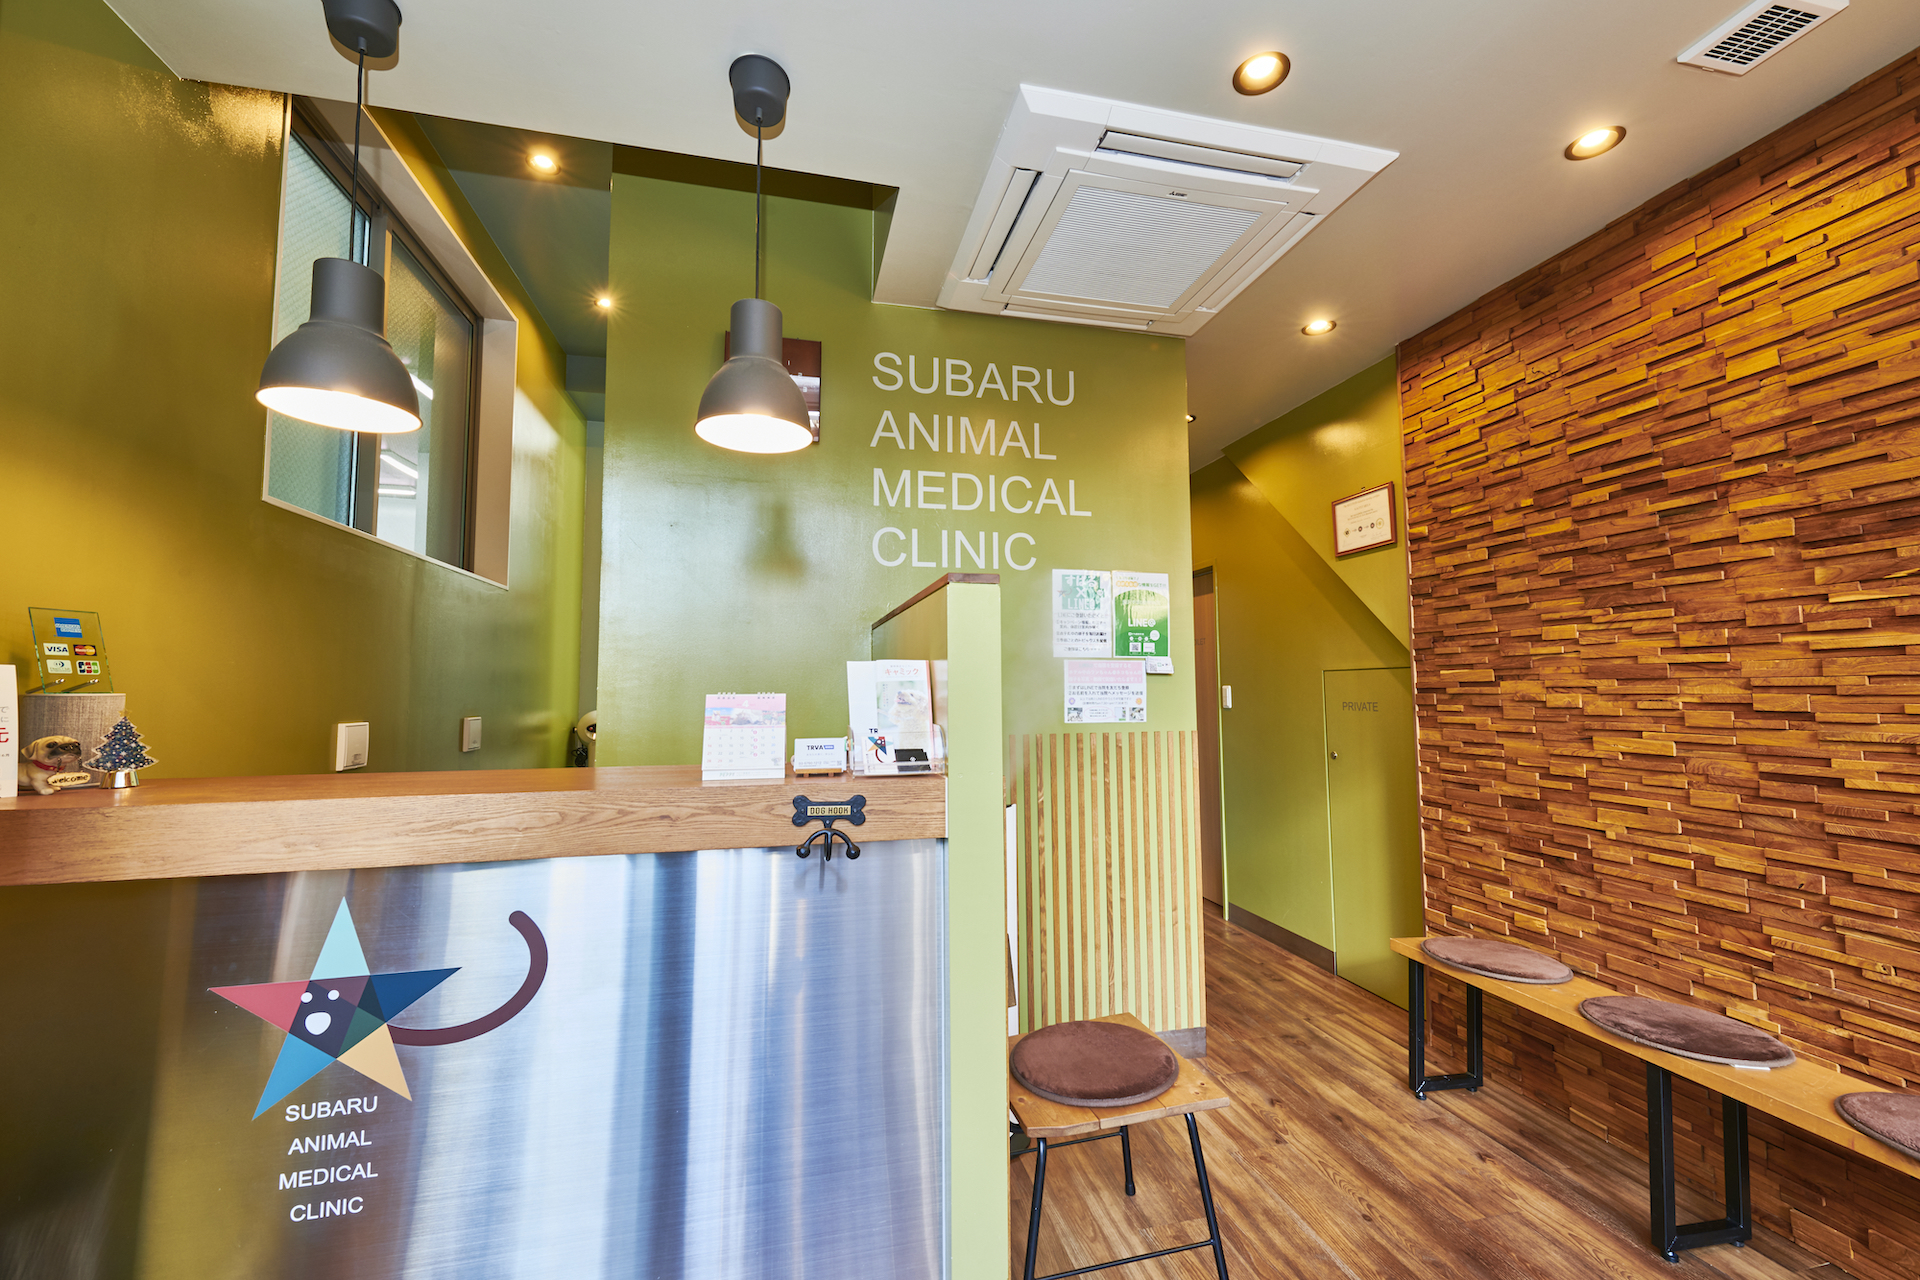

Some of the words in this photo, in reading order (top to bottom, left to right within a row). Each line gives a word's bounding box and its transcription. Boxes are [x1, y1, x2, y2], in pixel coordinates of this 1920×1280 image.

[872, 352, 1074, 406] SUBARU
[870, 410, 1057, 460] ANIMAL
[873, 468, 1092, 517] MEDICAL
[872, 527, 1036, 570] CLINIC
[1128, 618, 1156, 627] LINE@
[1342, 702, 1378, 712] PRIVATE
[51, 774, 88, 784] welcome
[285, 1096, 378, 1122] SUBARU
[288, 1130, 372, 1155] ANIMAL
[279, 1162, 378, 1190] MEDICAL
[290, 1196, 364, 1222] CLINIC
